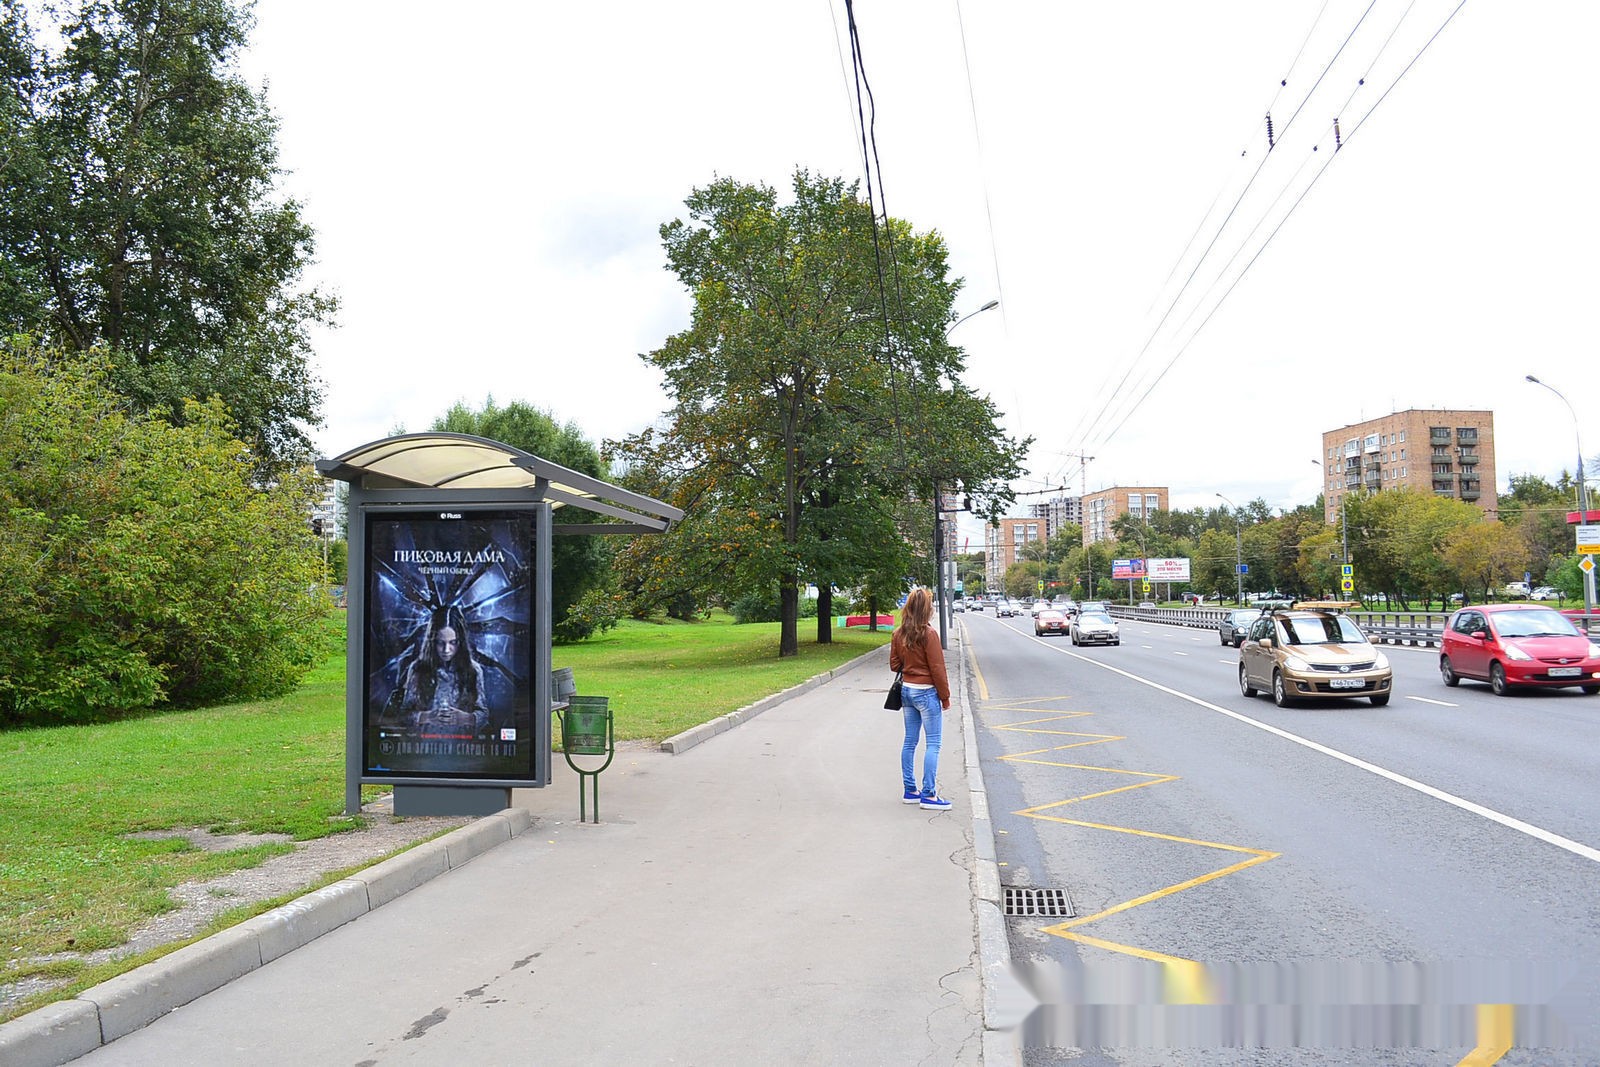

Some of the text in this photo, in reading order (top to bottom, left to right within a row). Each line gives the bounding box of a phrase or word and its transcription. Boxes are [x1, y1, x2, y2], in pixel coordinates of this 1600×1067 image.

[394, 550, 506, 565] ПИКОВАЯ ДАМА
[449, 566, 474, 576] ОБРЯД
